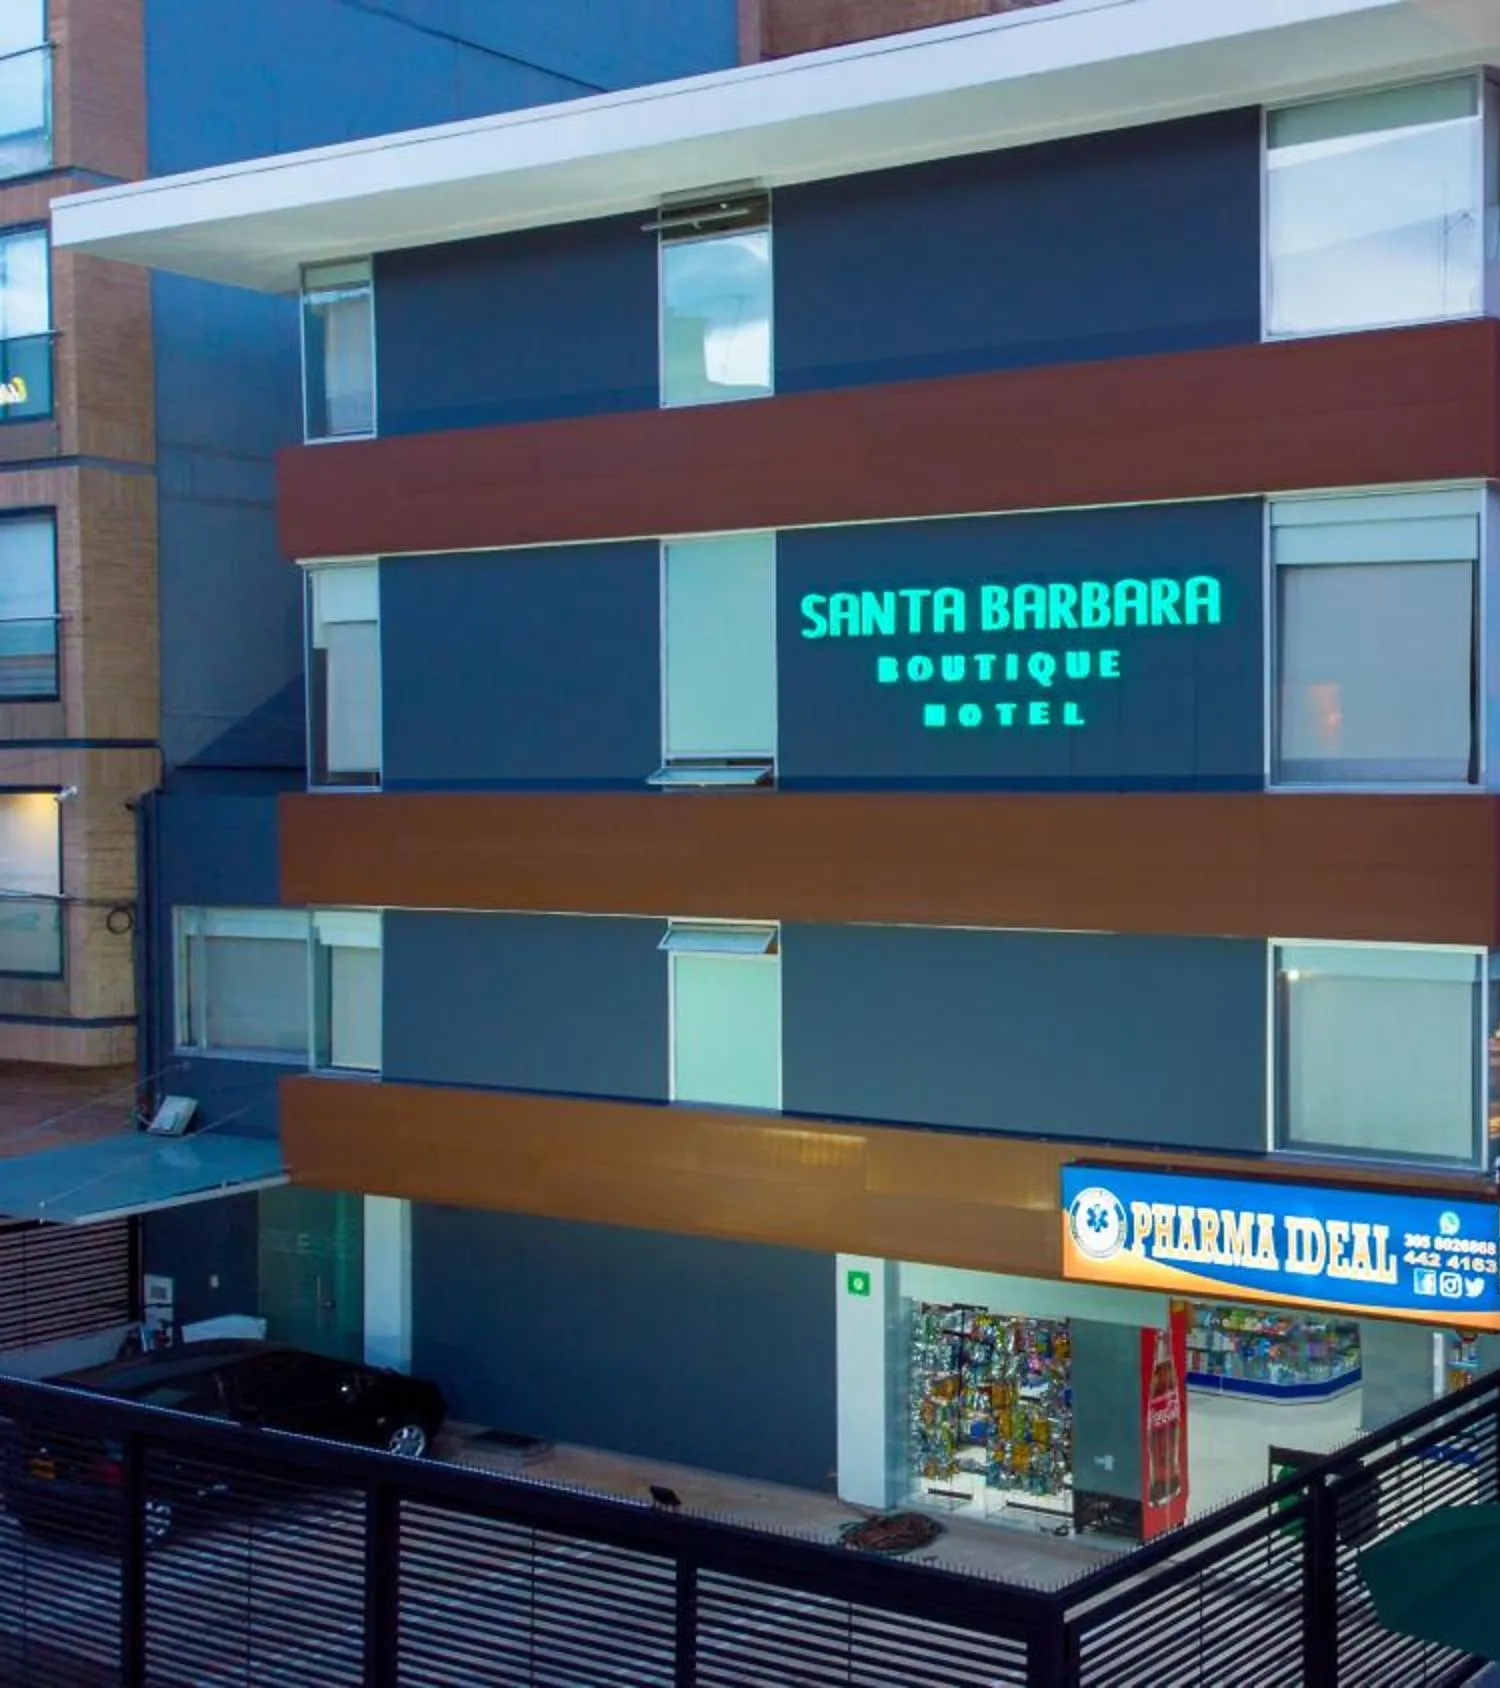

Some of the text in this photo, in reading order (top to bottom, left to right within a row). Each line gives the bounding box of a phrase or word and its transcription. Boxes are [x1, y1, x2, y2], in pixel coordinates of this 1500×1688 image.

[801, 576, 1221, 638] SANTA BARBARA
[877, 650, 1121, 686] BOUTIQUE
[923, 702, 1086, 727] HOTEL
[1129, 1201, 1399, 1285] PHARMA IDEAL
[1403, 1250, 1441, 1268] 442
